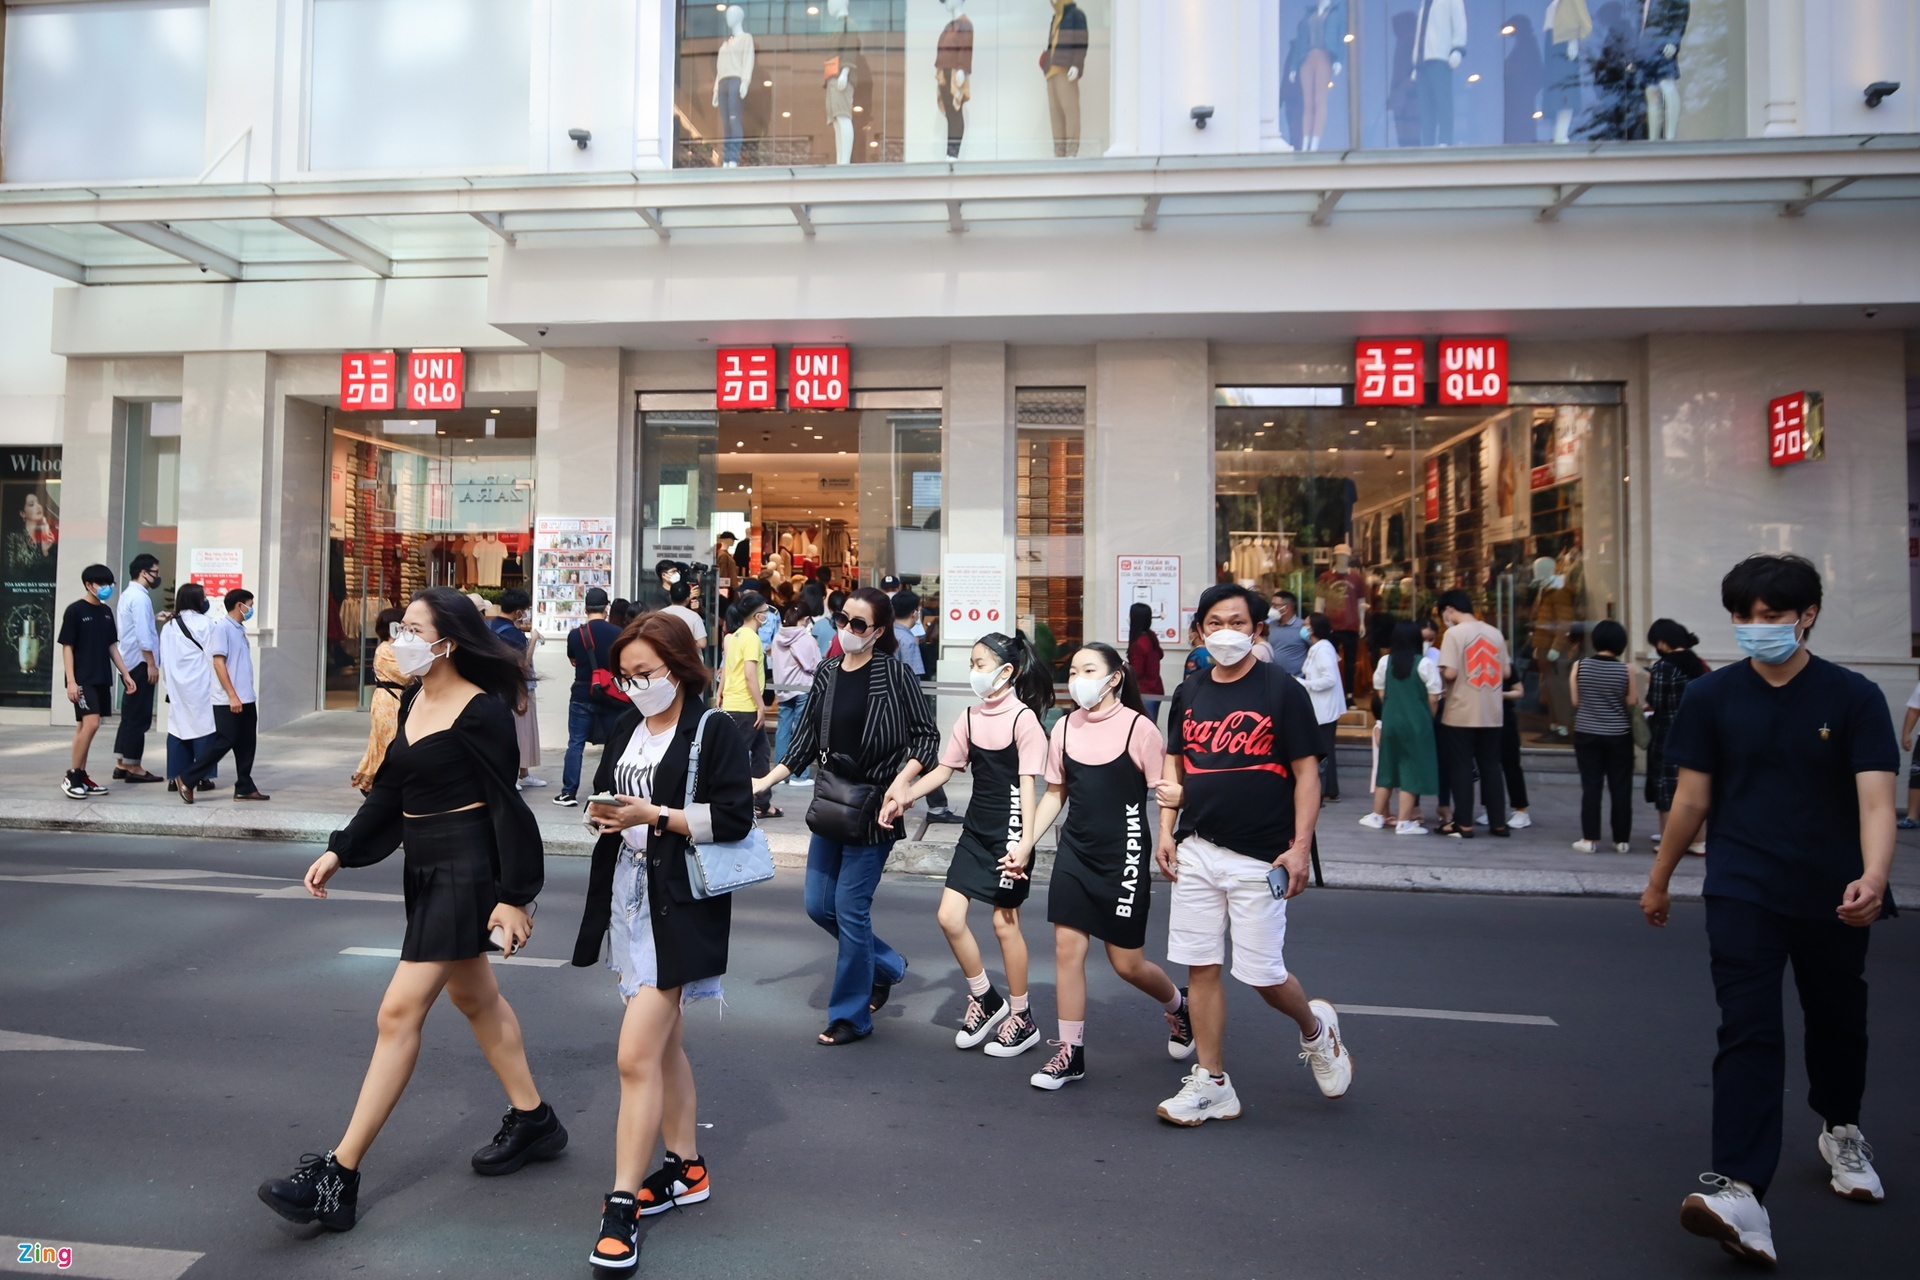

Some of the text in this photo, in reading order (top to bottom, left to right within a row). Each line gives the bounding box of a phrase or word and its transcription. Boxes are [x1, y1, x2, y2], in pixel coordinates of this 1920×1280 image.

[349, 359, 388, 379] ユニ
[414, 358, 453, 379] UNI
[724, 355, 768, 376] ユニ
[795, 355, 838, 376] UNI
[1364, 348, 1415, 371] ユニ
[1445, 347, 1495, 370] UNI
[347, 383, 388, 403] クロ
[413, 382, 456, 406] QLO
[723, 380, 768, 401] クロ
[795, 379, 842, 404] QLO
[1363, 374, 1415, 397] クロ
[1446, 373, 1500, 400] QLO
[10, 454, 62, 472] Whoo
